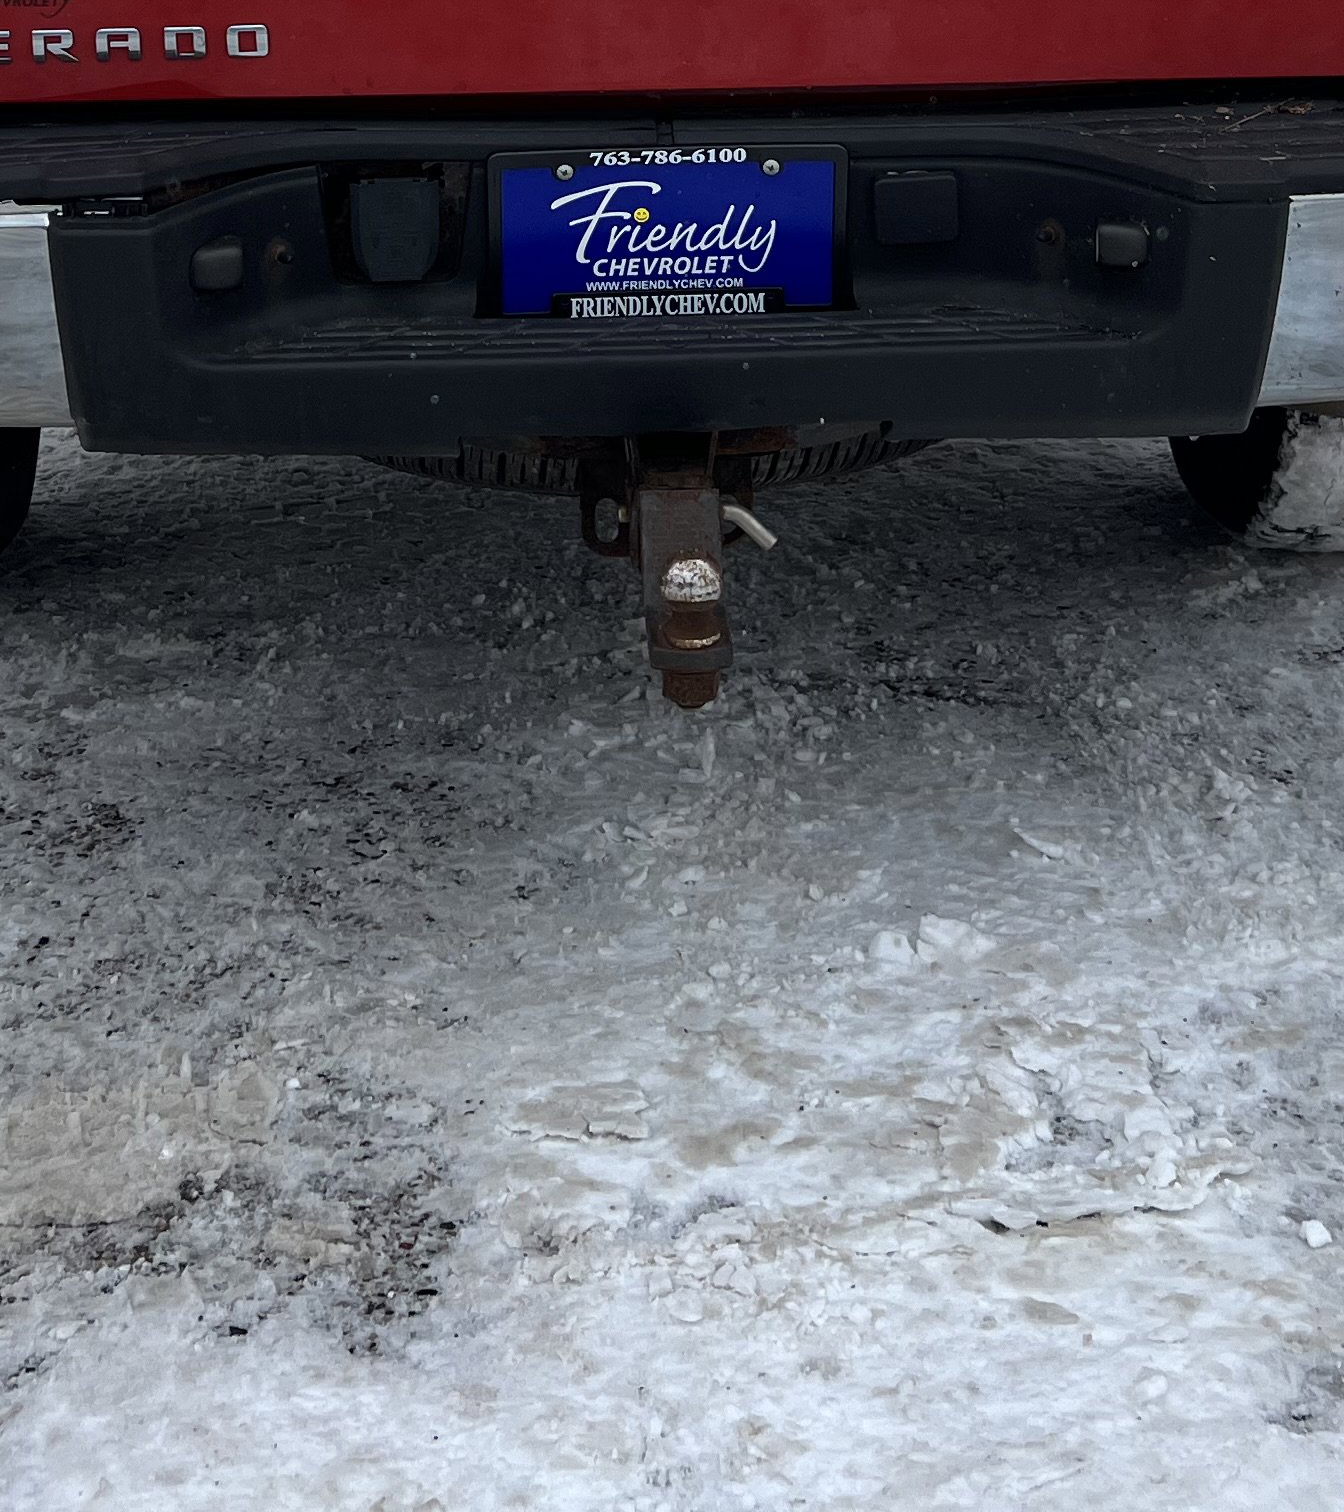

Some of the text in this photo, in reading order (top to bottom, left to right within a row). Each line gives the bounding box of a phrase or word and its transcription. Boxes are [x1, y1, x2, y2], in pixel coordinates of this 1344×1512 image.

[589, 148, 747, 167] 763-786-6100
[550, 180, 776, 273] Friendly
[592, 255, 735, 277] CHEVROLET
[586, 278, 744, 292] WWW.FRIENDLYCHEV.COM
[570, 292, 766, 319] FRIENDLYCHEV.COM
